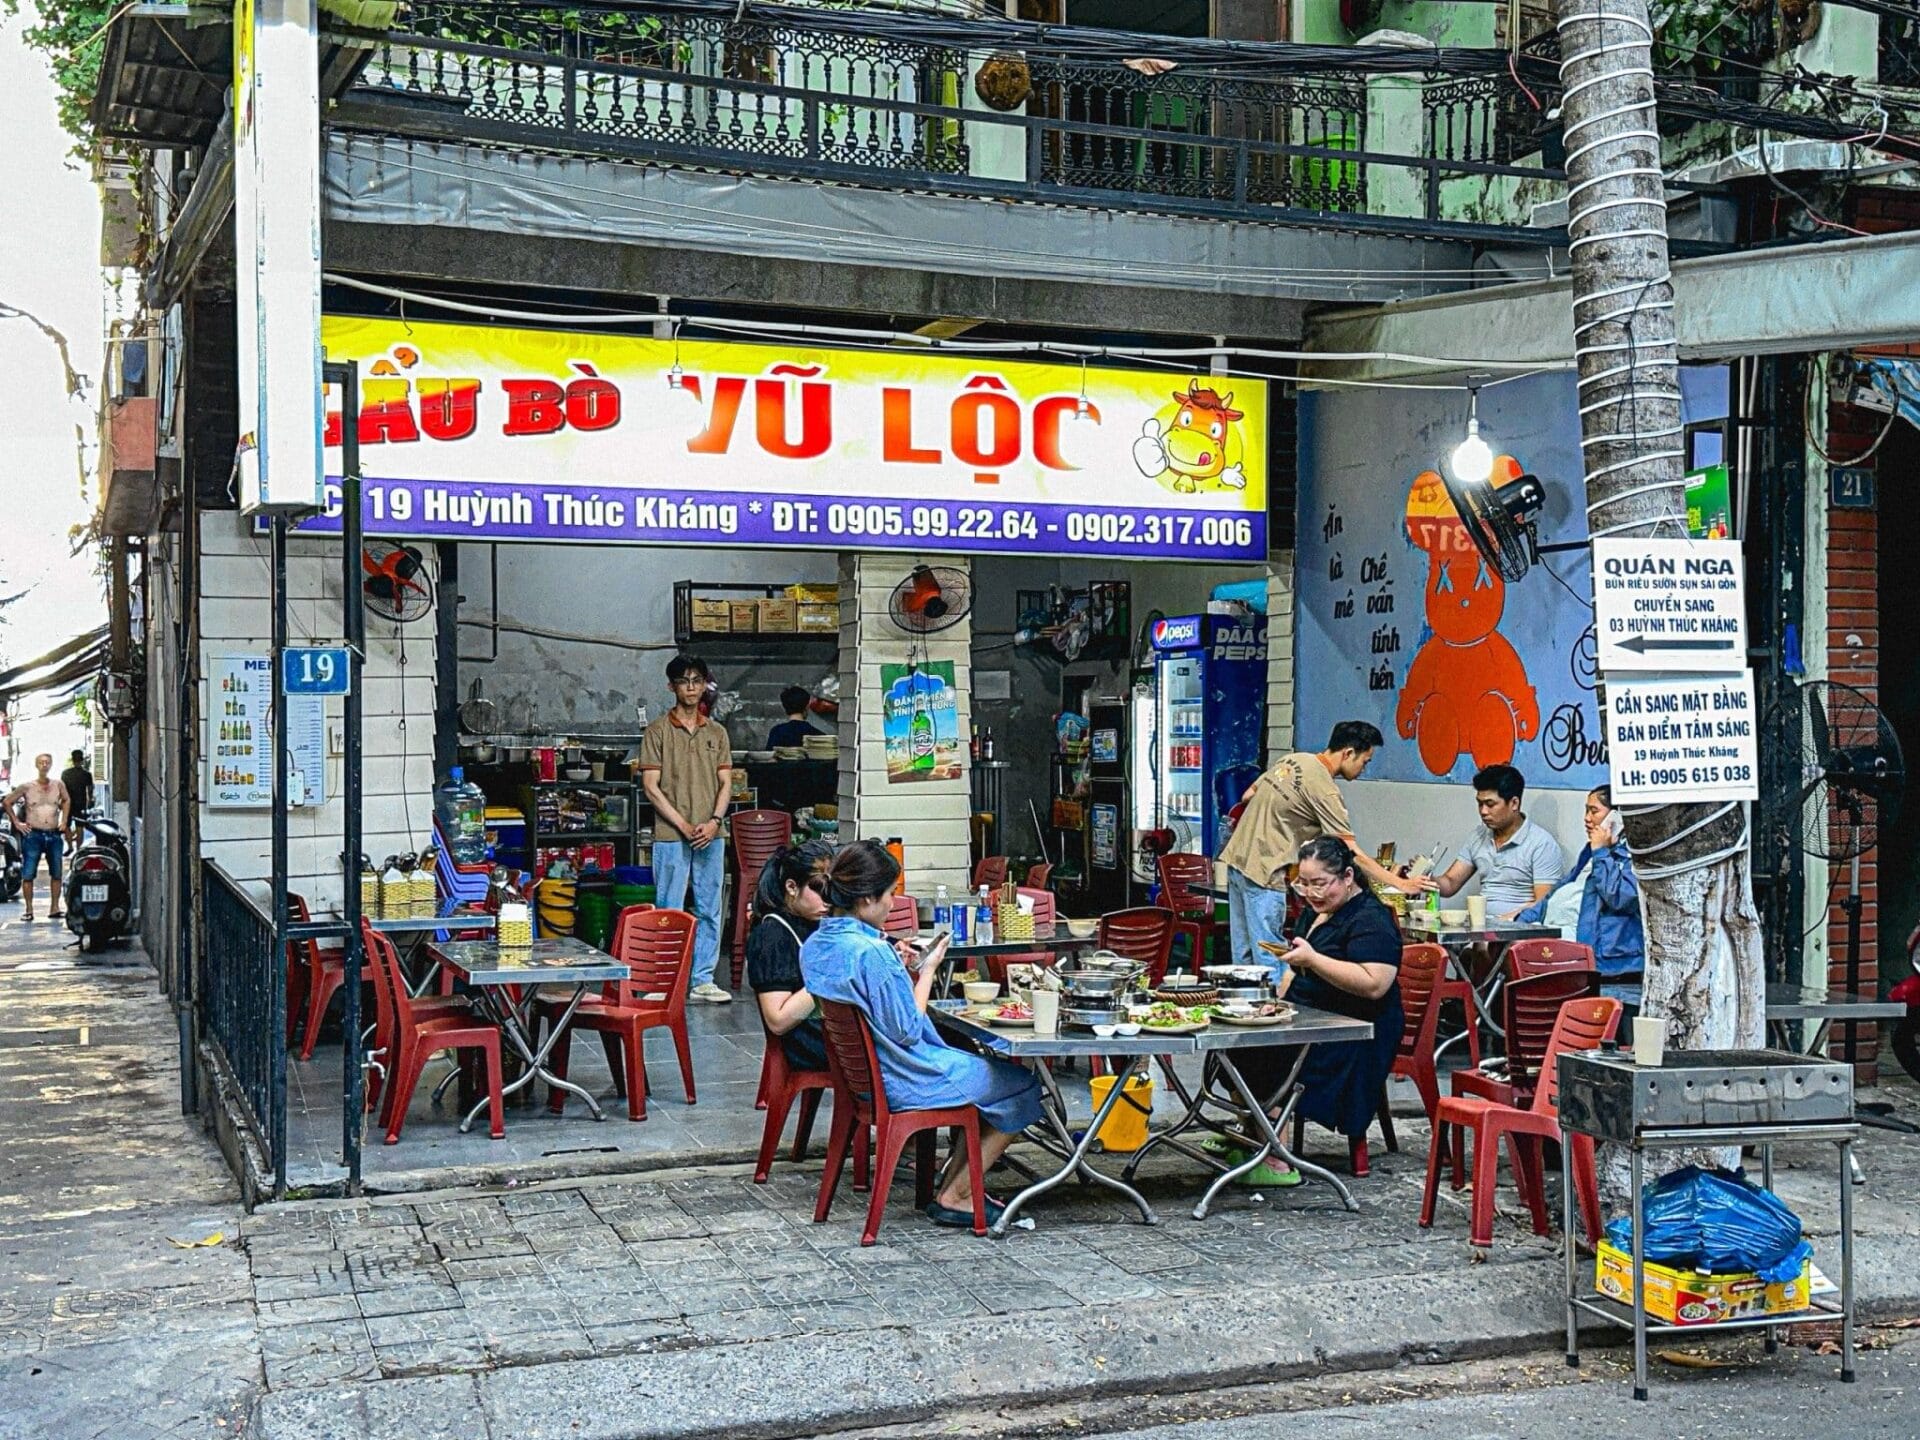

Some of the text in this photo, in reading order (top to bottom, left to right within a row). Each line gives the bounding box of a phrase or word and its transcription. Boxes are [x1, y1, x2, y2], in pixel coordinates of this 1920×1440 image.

[501, 363, 622, 435] BÒ
[667, 364, 832, 459] VŨ
[882, 376, 1102, 484] LỘC
[1841, 475, 1862, 496] 21
[368, 487, 413, 521] 19
[424, 488, 533, 528] Huỳnh
[543, 493, 625, 526] Thúc
[637, 496, 738, 533] Kháng
[772, 502, 819, 533] ĐT:
[827, 503, 1039, 540] 0905.99.22.64
[1066, 512, 1252, 546] 0902.317.006
[1361, 552, 1387, 584] Chê
[1604, 554, 1734, 577] QUÁN NGA
[1701, 576, 1715, 590] SÀI
[1718, 577, 1737, 590] GÒN
[1334, 588, 1354, 619] mê
[1634, 592, 1714, 612] CHUYỂN SANG
[1168, 623, 1194, 642] pepsi
[1610, 615, 1738, 633] 03 HUỲNH THÚC KHÁNG
[1213, 645, 1267, 660] PEPS
[300, 652, 334, 683] 19
[1645, 694, 1678, 713] SANG
[1682, 690, 1708, 716] MẶT
[1713, 684, 1747, 710] BẰNG
[1618, 722, 1645, 742] BÁN
[1649, 716, 1681, 740] ĐIỂM
[1717, 717, 1750, 738] SÁNG
[1634, 746, 1739, 762] 19 Huỳnh Thúc Kháng
[1622, 765, 1751, 786] LH: 0905 615 038
